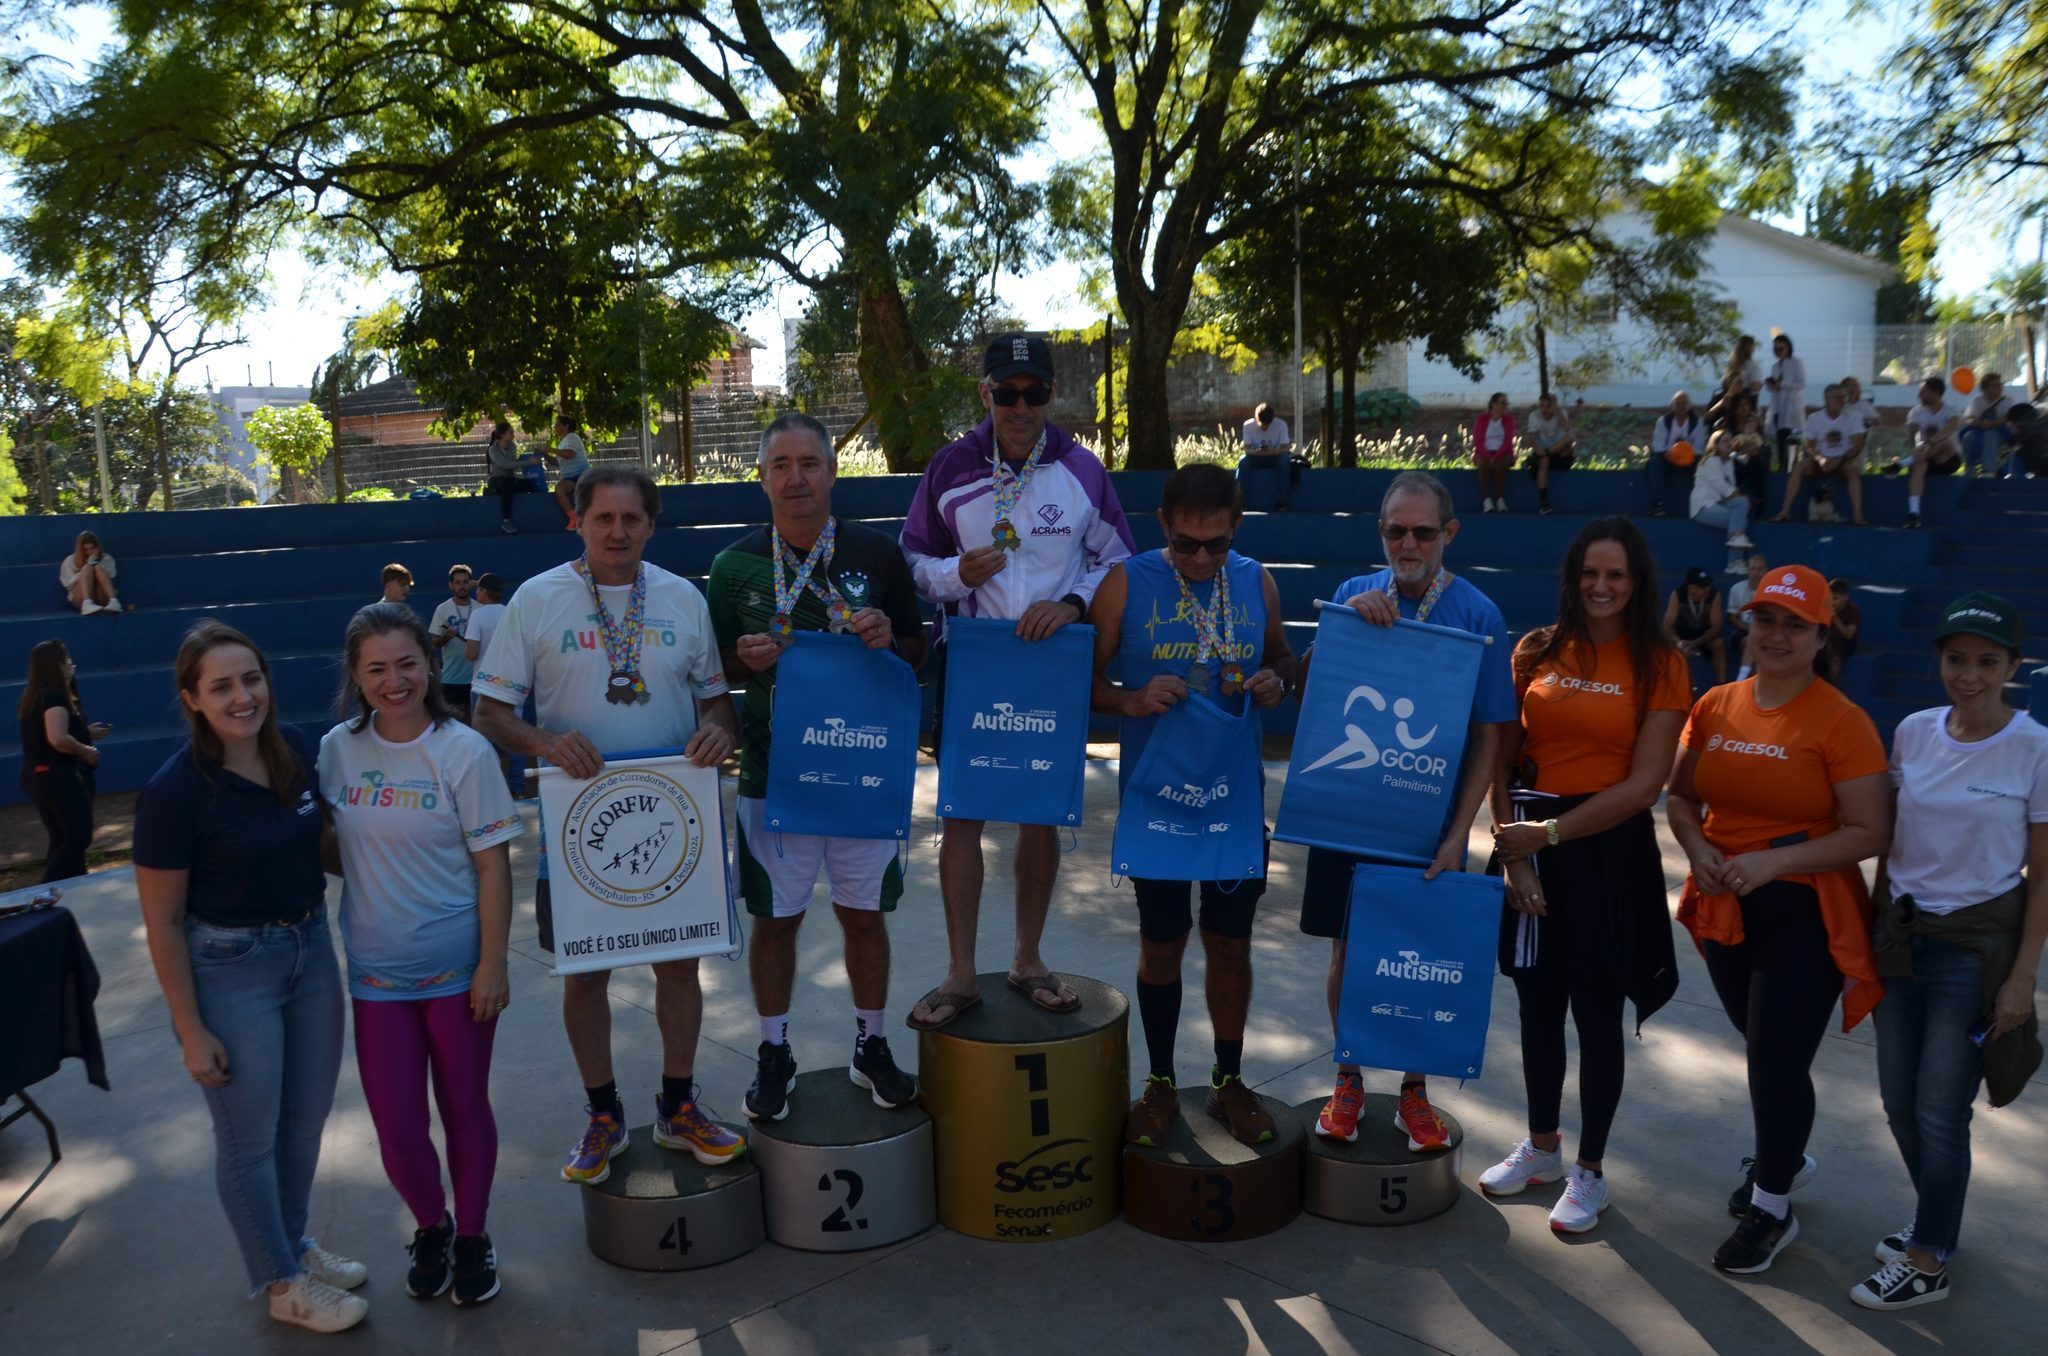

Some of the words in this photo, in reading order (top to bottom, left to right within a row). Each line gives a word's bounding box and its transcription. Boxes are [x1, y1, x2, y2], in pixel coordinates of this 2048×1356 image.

[1031, 526, 1071, 535] ACRAMS
[1764, 585, 1807, 601] CRESOL
[561, 629, 676, 653] Aumo
[1561, 677, 1624, 695] CRESOL
[972, 712, 1056, 733] Autismo
[802, 727, 887, 749] Autismo
[1723, 740, 1789, 760] CRESOL
[1381, 748, 1447, 777] GCOR
[336, 784, 438, 811] Autismo
[572, 782, 607, 822] Associação
[607, 776, 619, 786] de
[619, 773, 669, 789] Corredores
[668, 786, 678, 795] de
[675, 794, 689, 811] Rua
[1382, 774, 1441, 795] Palmitinho
[587, 795, 660, 852] ACORFW
[568, 841, 589, 881] Frederico
[674, 859, 693, 883] Desde
[690, 835, 699, 859] 2024
[563, 936, 594, 957] VOCÊ
[597, 934, 604, 952] É
[607, 936, 615, 951] O
[618, 933, 640, 949] SEU
[643, 928, 677, 946] ÚNICO
[680, 921, 720, 941] LIMITE!
[1375, 958, 1463, 984] Autismo
[1015, 1053, 1050, 1137] 1
[818, 1169, 868, 1232] 2
[995, 1196, 1093, 1218] Fecomércio
[1190, 1174, 1234, 1237] 3
[1379, 1176, 1408, 1214] 5
[659, 1216, 692, 1255] 4
[996, 1222, 1052, 1238] Senac
